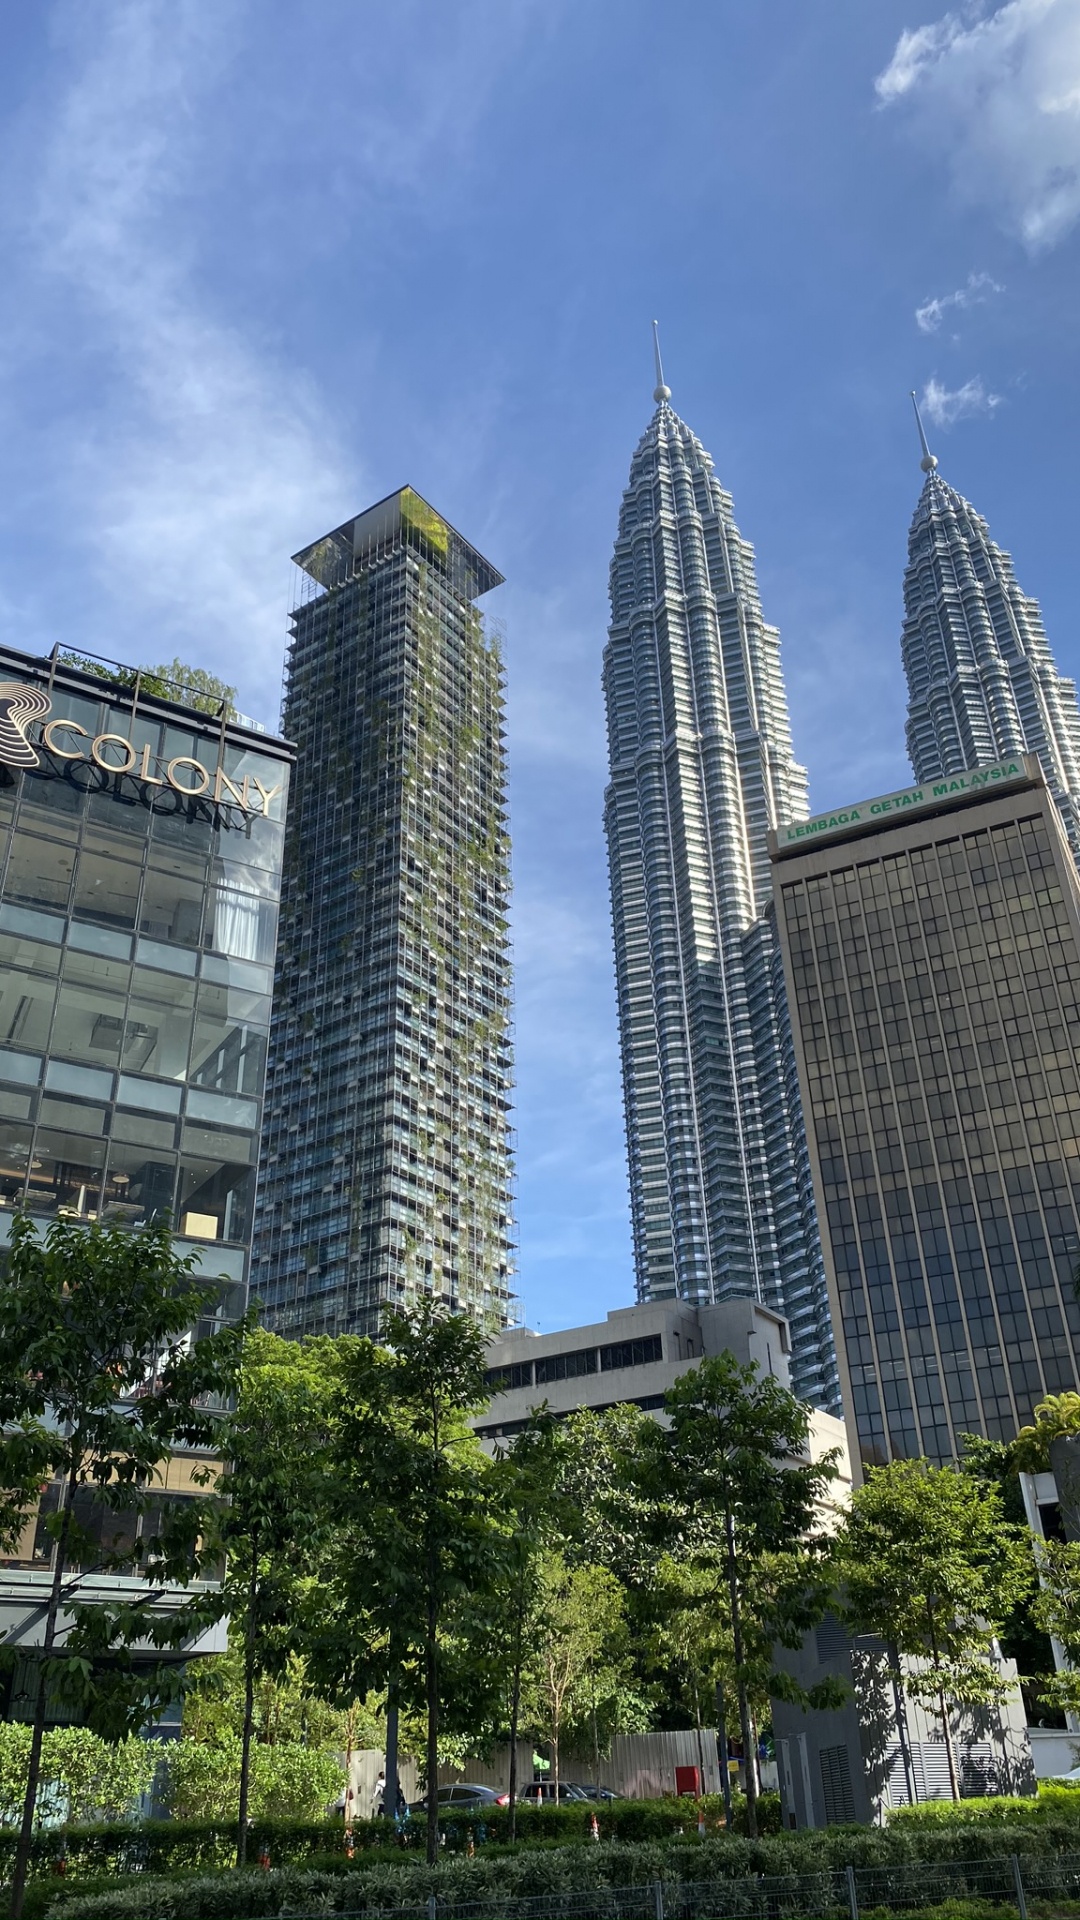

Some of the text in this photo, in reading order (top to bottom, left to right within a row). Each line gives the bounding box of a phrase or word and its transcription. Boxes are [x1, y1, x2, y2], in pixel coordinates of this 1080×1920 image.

[44, 720, 281, 817] COLONY
[787, 763, 1019, 840] LEMBAGA GETAH MALAYSIA
